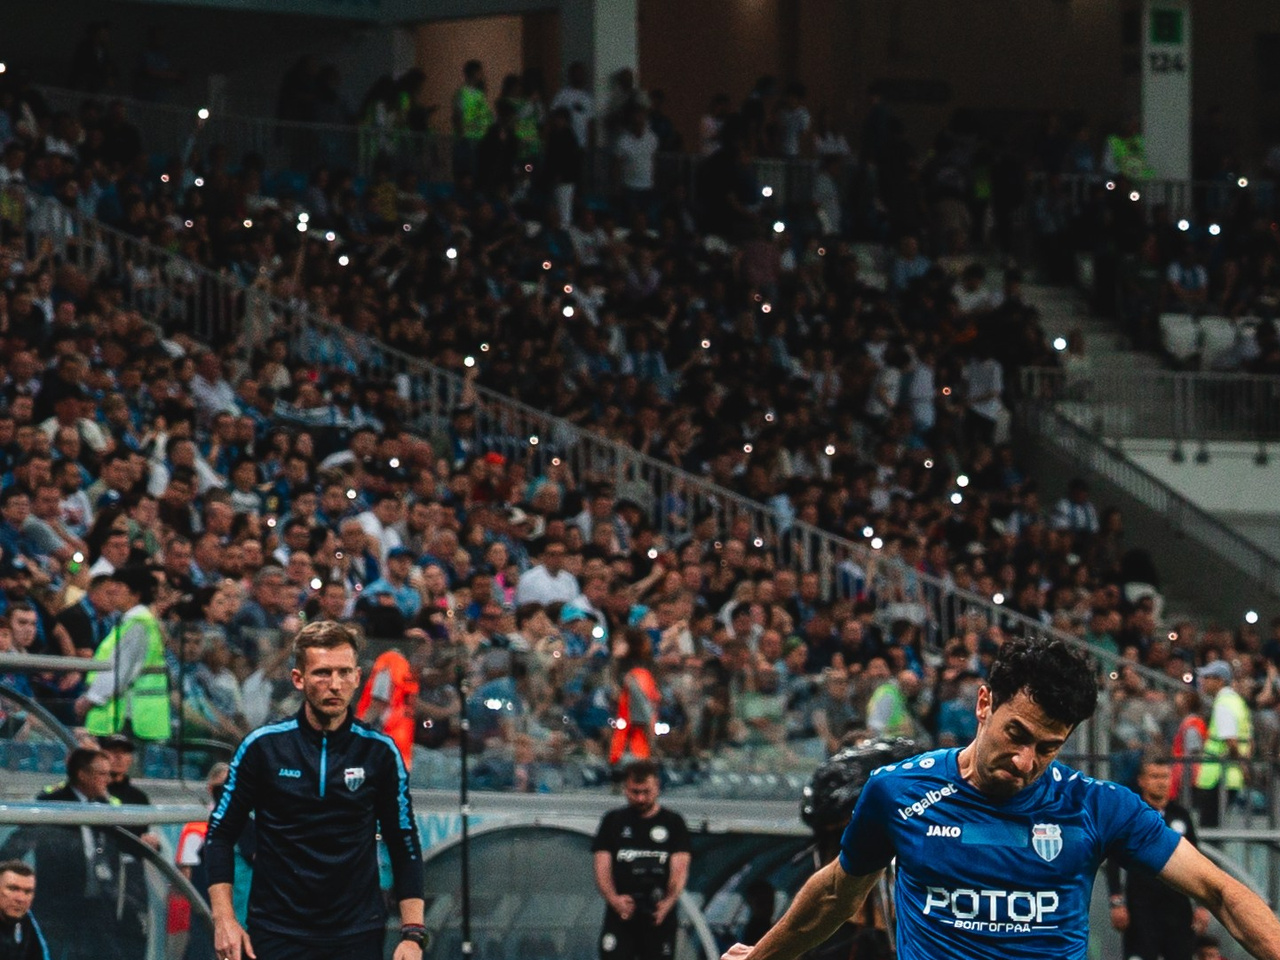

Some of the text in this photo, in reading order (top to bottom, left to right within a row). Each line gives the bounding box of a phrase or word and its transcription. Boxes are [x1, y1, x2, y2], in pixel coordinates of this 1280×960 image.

[1149, 51, 1186, 74] 124
[278, 767, 302, 779] JAKO
[897, 783, 958, 820] legalbet
[926, 825, 961, 838] JAKO
[922, 886, 1060, 923] РОТОР
[953, 920, 1032, 933] ВОЛГОГРАД
